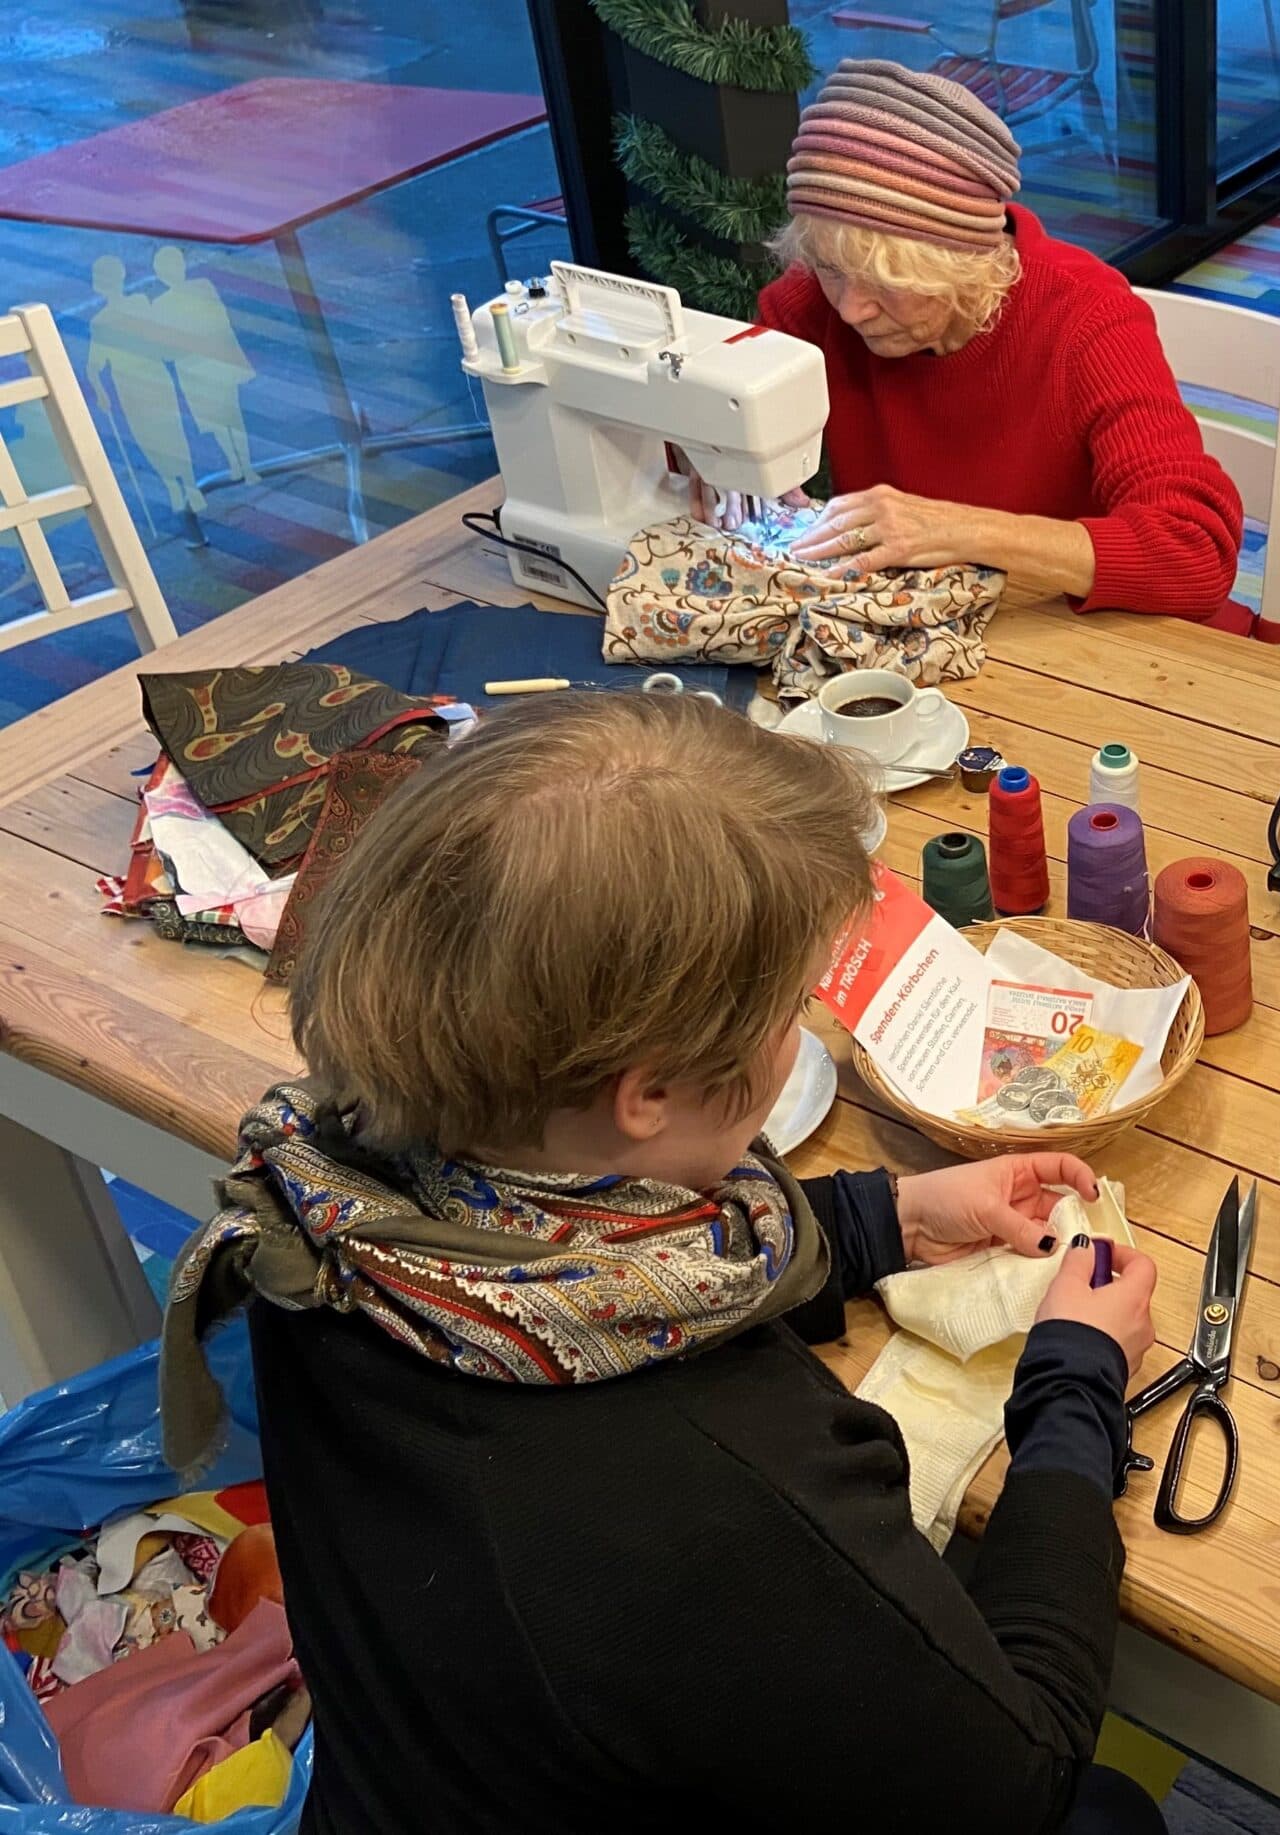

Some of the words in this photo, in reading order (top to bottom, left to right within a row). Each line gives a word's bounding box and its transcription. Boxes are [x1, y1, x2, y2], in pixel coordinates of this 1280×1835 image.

[839, 938, 872, 992] TRÖSCH
[833, 990, 847, 1007] im
[870, 948, 939, 1045] Spenden-Körbchen
[1051, 1011, 1084, 1036] 20
[1072, 1033, 1094, 1053] 10
